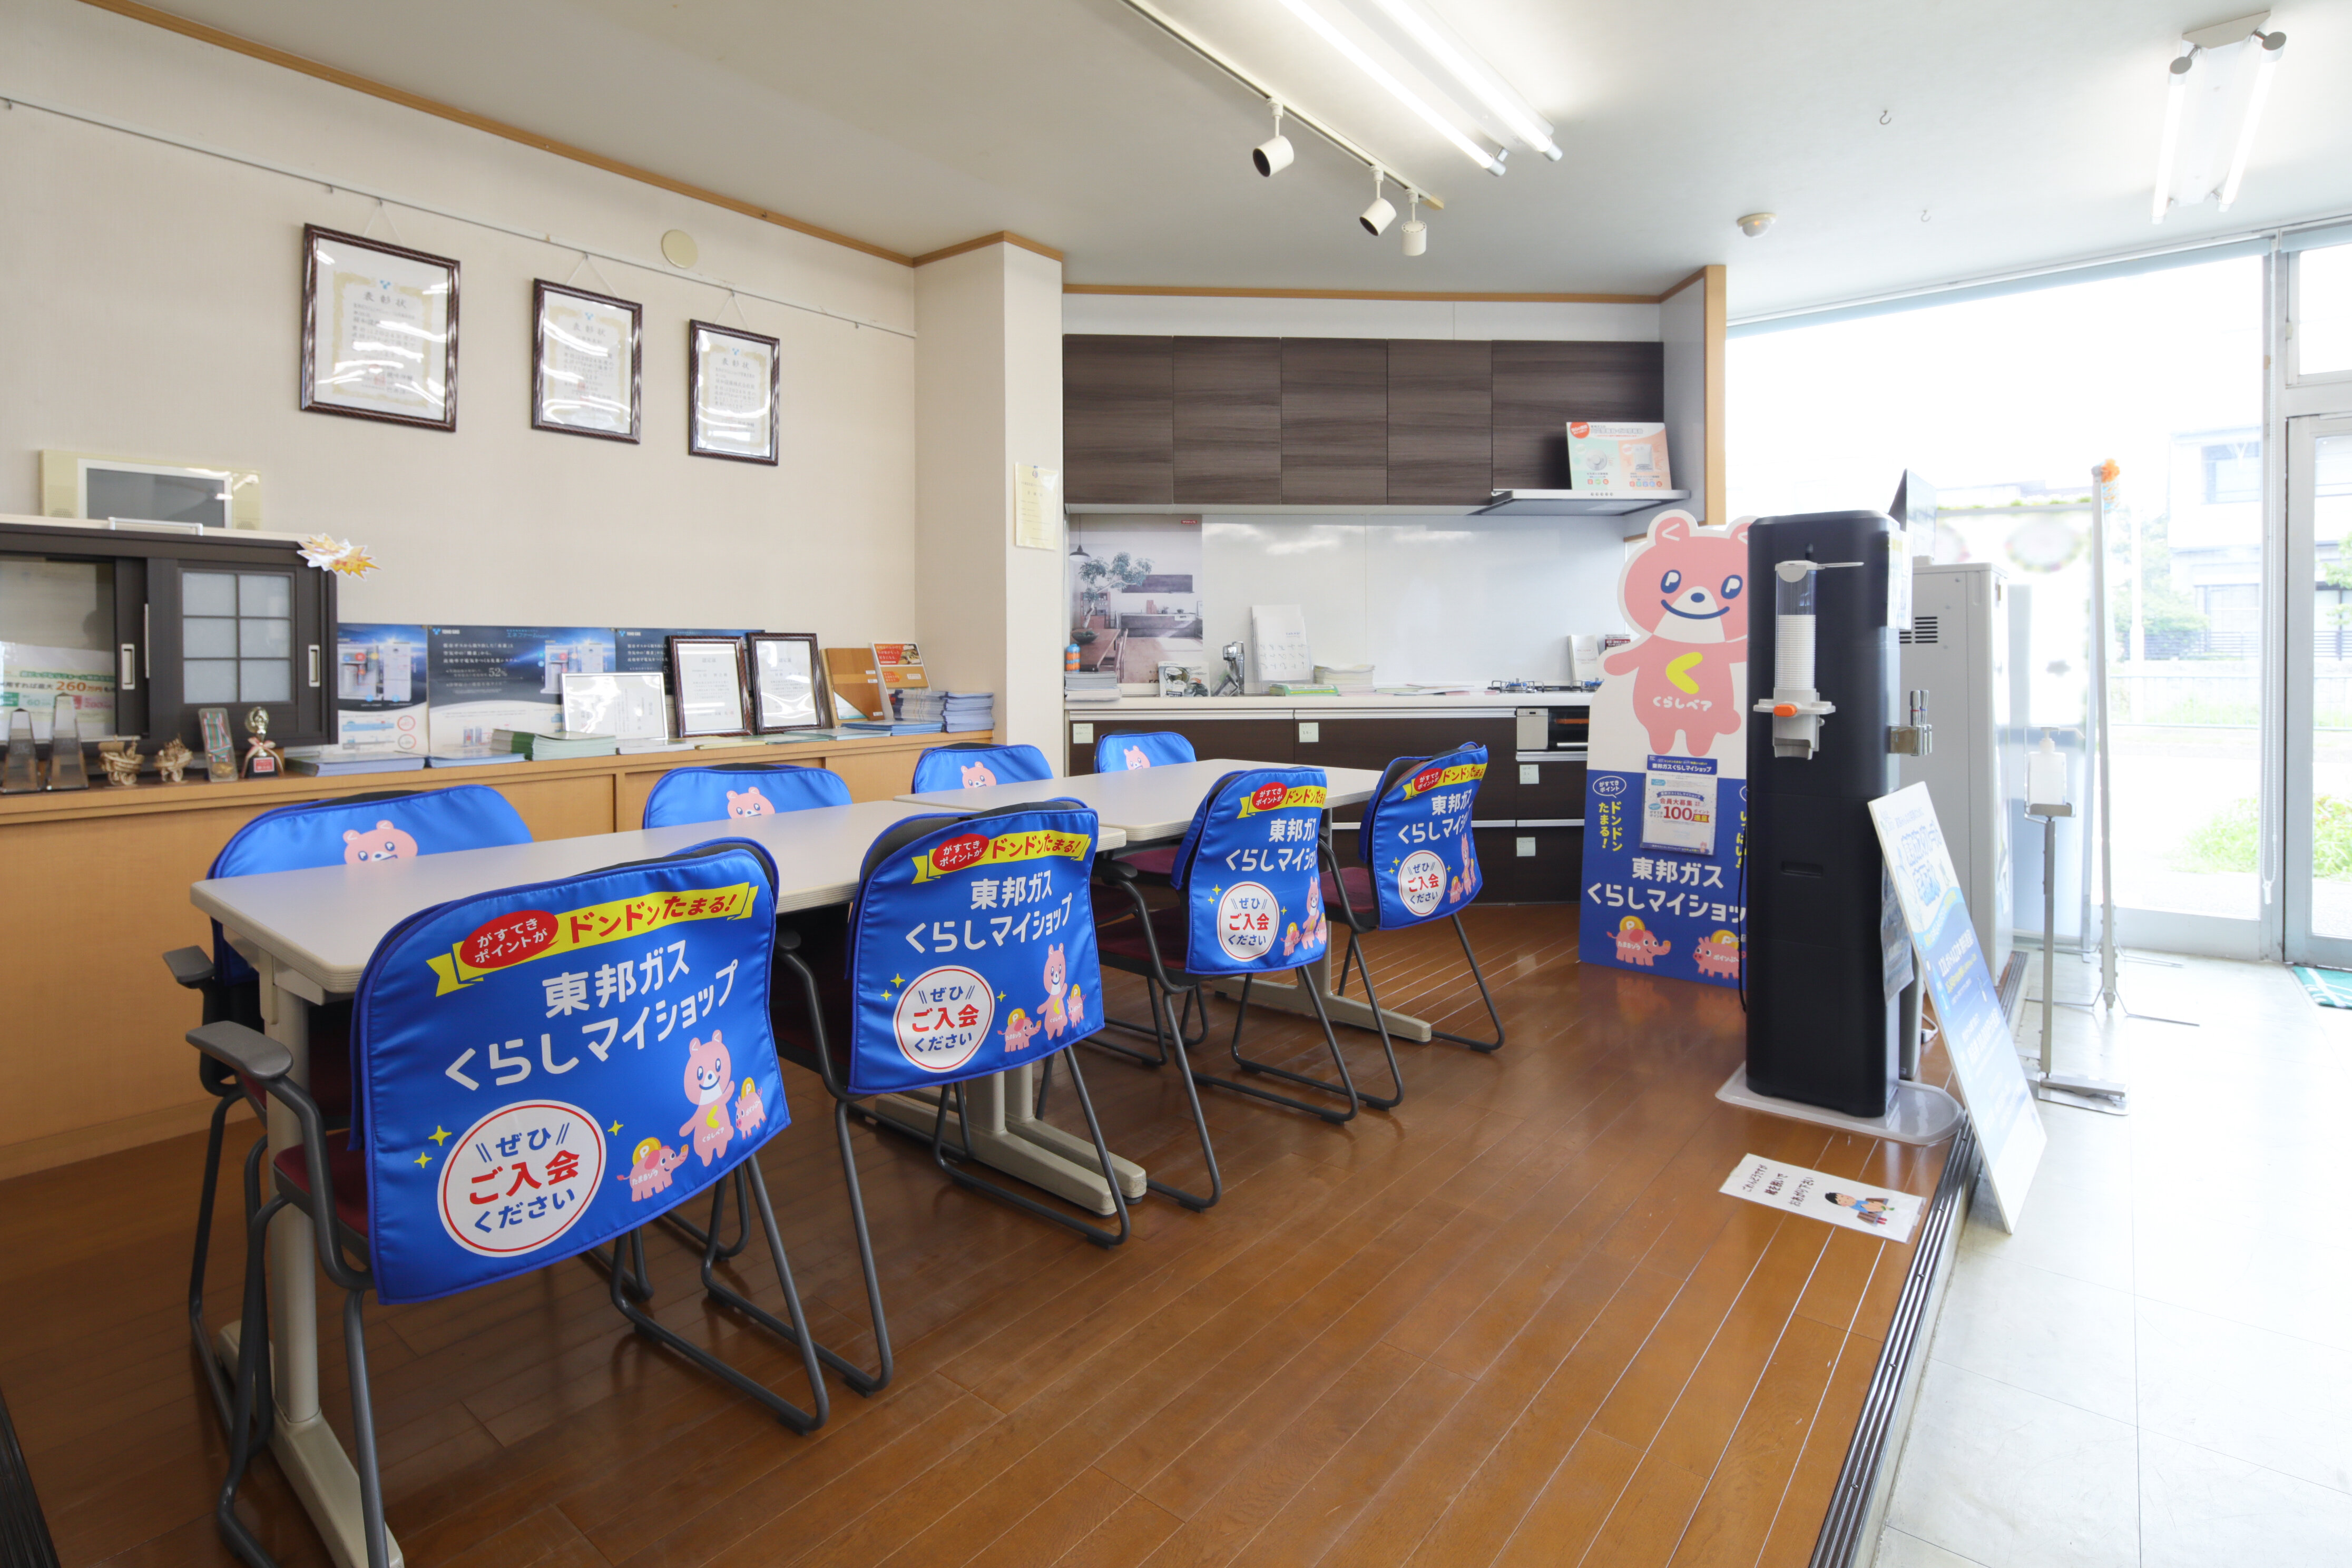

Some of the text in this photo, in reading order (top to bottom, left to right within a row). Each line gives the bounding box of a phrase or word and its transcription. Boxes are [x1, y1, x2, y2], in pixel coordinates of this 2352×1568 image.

[365, 291, 407, 309] 表彰状
[723, 358, 749, 369] 表彰状
[1653, 696, 1712, 711] くらしベア
[1419, 771, 1439, 783] がすてき
[1652, 762, 1712, 773] 東邦ガスくらしマイショップ
[1256, 795, 1283, 806] ポイントが
[1260, 788, 1282, 798] がすてき
[1431, 789, 1472, 816] 東邦ガス
[1660, 798, 1692, 806] 会員大募集
[1663, 806, 1692, 821] 100
[1269, 818, 1317, 842] 東邦ガス
[1599, 802, 1610, 848] たまる!
[1611, 801, 1623, 851] ドンドン
[943, 840, 980, 856] がすてき
[993, 833, 1081, 859] ドンドンたまる!
[939, 848, 982, 867] ポイントが
[1413, 862, 1429, 874] ぜひ
[1632, 857, 1724, 889] 東邦ガス
[971, 869, 1052, 910] 東邦ガス
[1408, 874, 1439, 893] ご入会
[1239, 897, 1260, 909] ぜひ
[1410, 891, 1438, 905] ください
[570, 894, 737, 944] ドンドンたまる!
[905, 892, 1072, 954] くらしマイショップ
[1229, 913, 1270, 930] ご入会
[477, 918, 537, 948] がすてき
[1228, 934, 1266, 946] ください
[475, 928, 547, 963] ポイントが
[1618, 940, 1641, 950] たまるゾウ
[542, 940, 690, 1018] 東邦ガス
[930, 986, 963, 1002] ぜひ
[445, 959, 738, 1091] くらしマイショップ
[912, 1004, 979, 1033] ご入会
[914, 1032, 972, 1053] ください
[496, 1127, 551, 1158] ぜひ
[701, 1127, 724, 1142] くらしベア
[469, 1150, 580, 1204] ご入会
[632, 1169, 659, 1185] たまるゾウ
[1742, 1164, 1767, 1192] ごめんどうですが
[1788, 1177, 1815, 1207] おあがり下さい
[474, 1188, 575, 1233] ください
